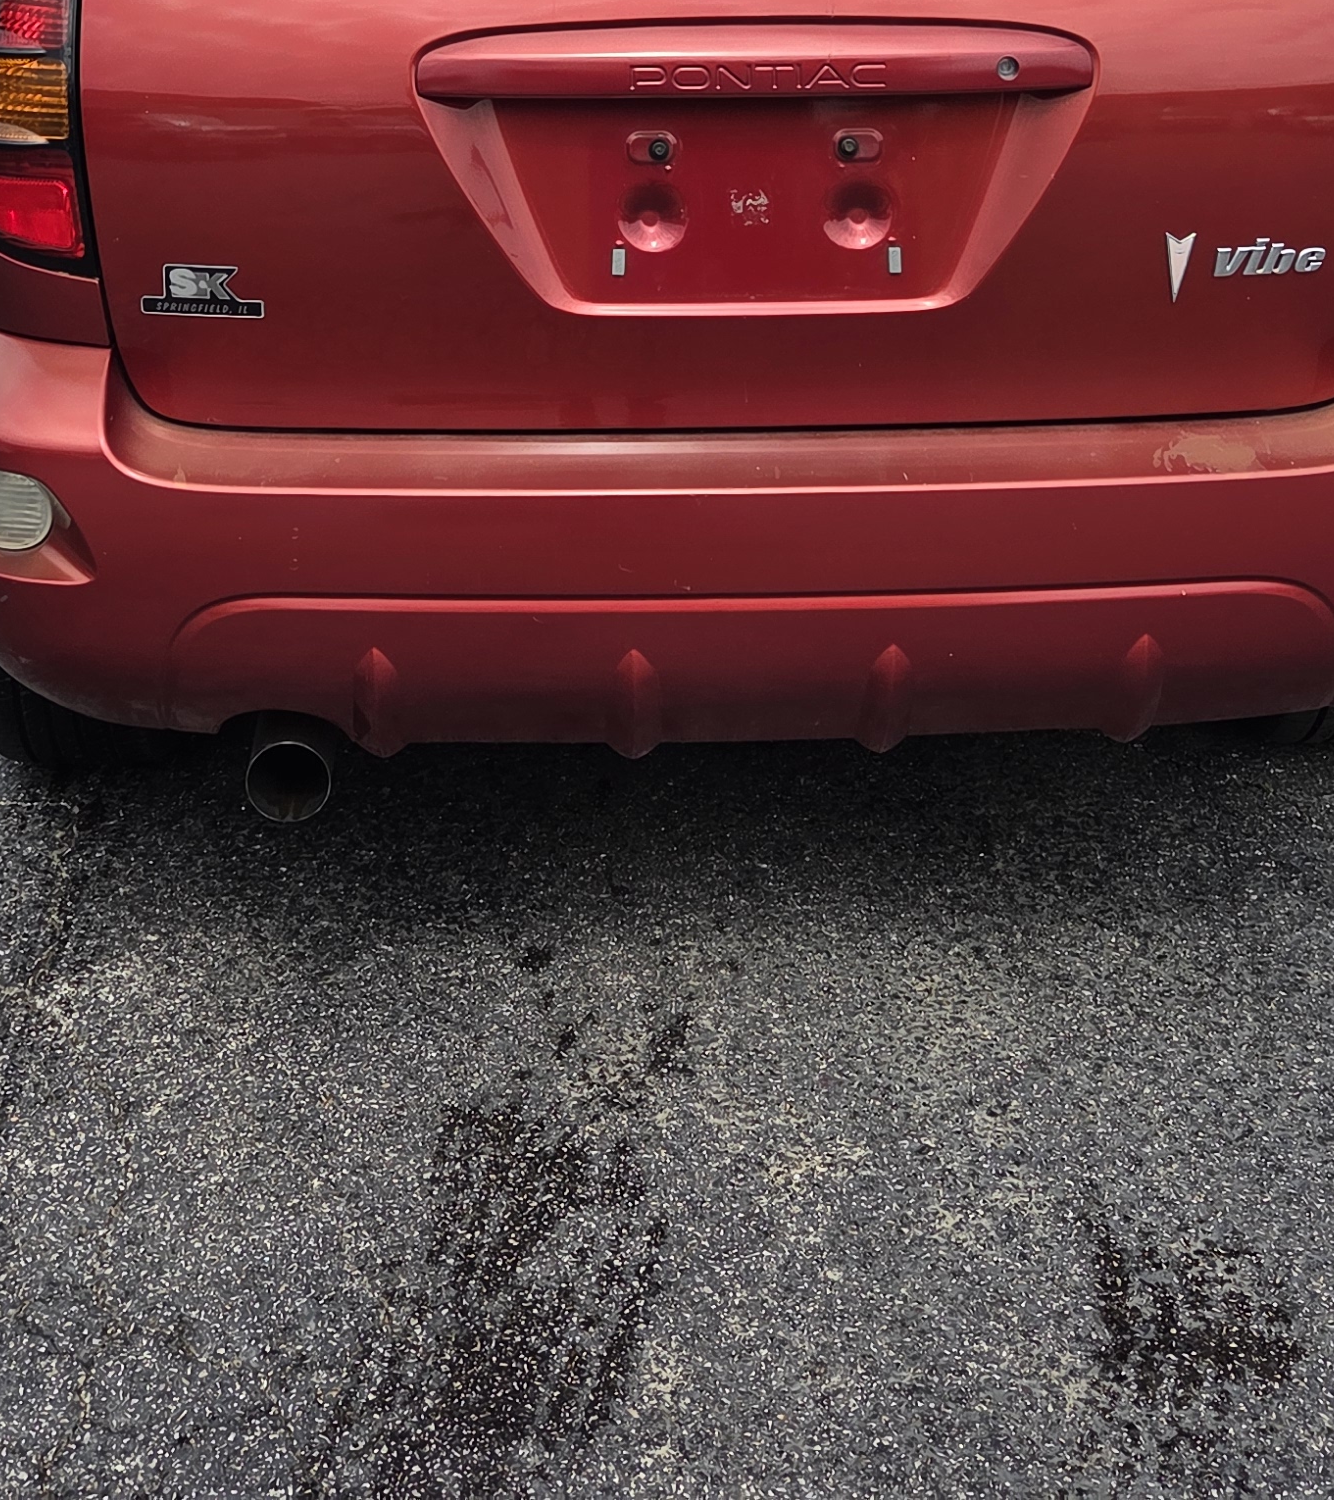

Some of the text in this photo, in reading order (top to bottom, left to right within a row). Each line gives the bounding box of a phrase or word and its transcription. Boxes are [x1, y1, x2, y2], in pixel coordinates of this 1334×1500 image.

[629, 64, 887, 91] PONTIAC
[1213, 237, 1326, 277] vibe
[237, 305, 248, 314] IL
